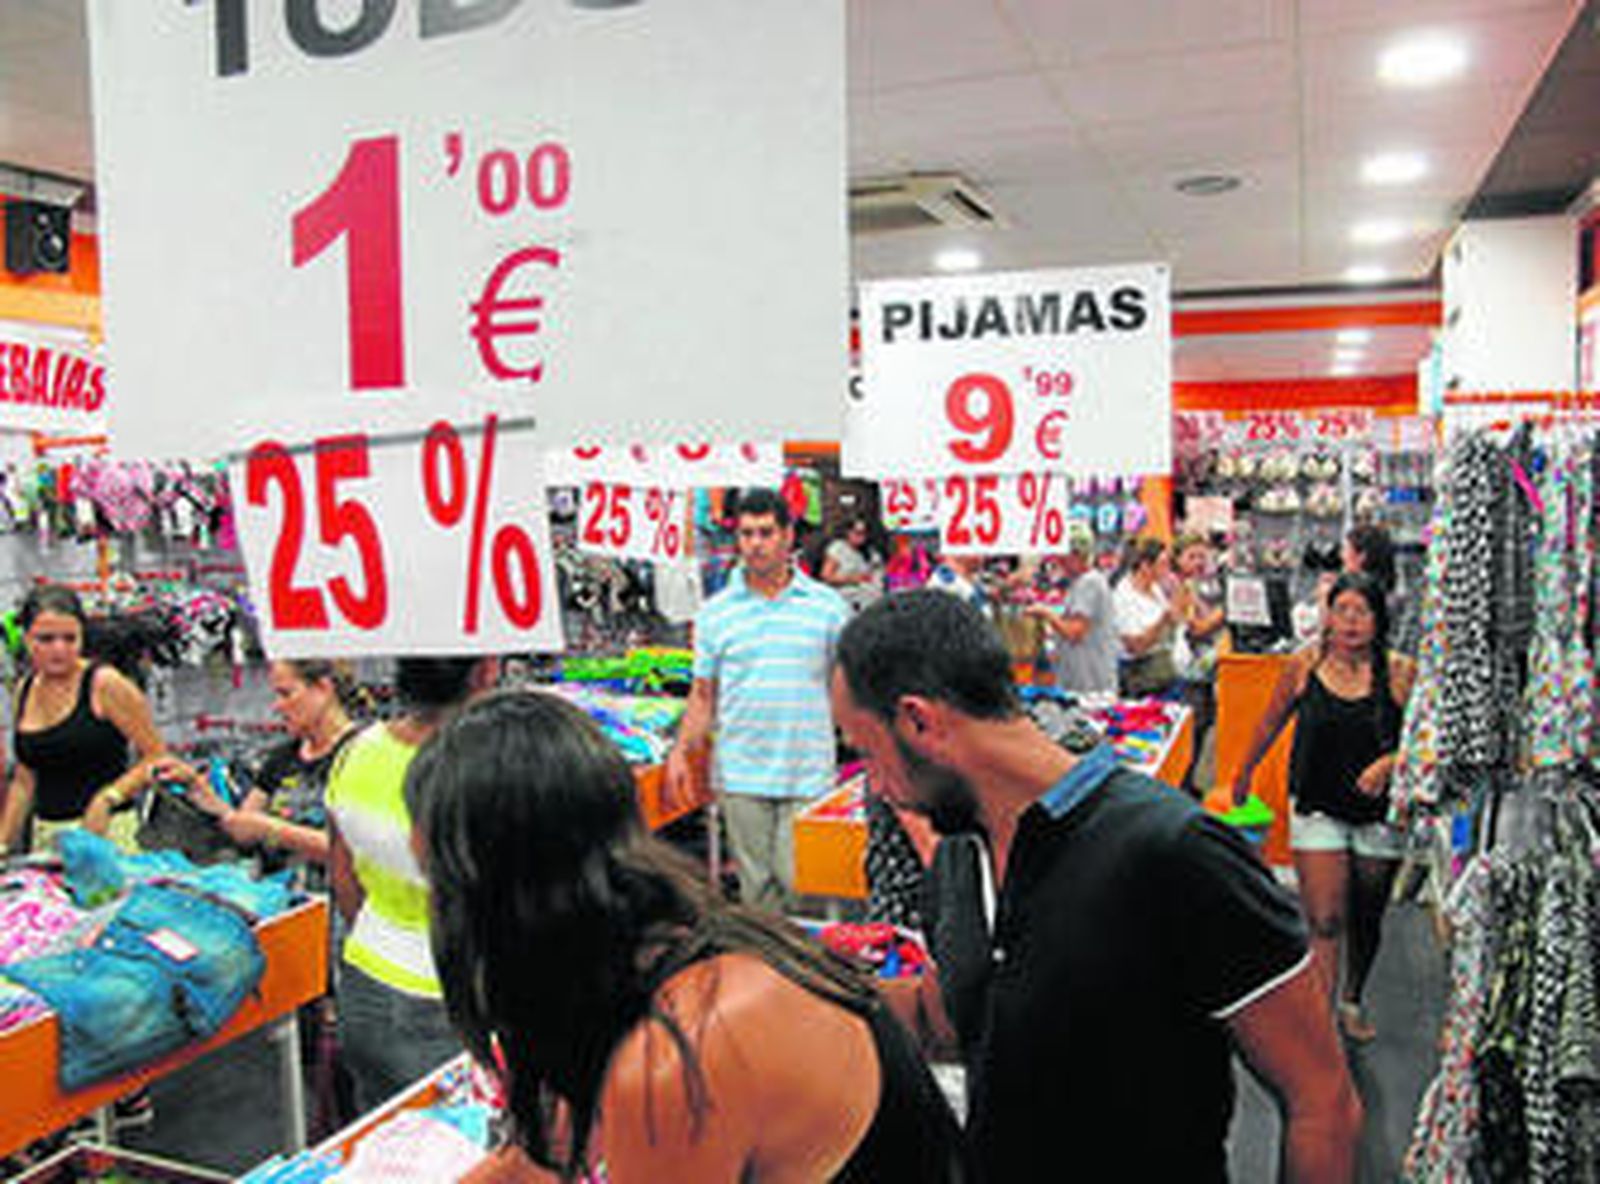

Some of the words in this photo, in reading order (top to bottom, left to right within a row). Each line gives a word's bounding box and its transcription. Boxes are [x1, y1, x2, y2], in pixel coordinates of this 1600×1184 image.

[292, 135, 405, 389] 1
[470, 247, 560, 382] €
[881, 287, 1147, 343] PIJAMAS
[945, 372, 1015, 464] 9
[1036, 410, 1068, 460] €
